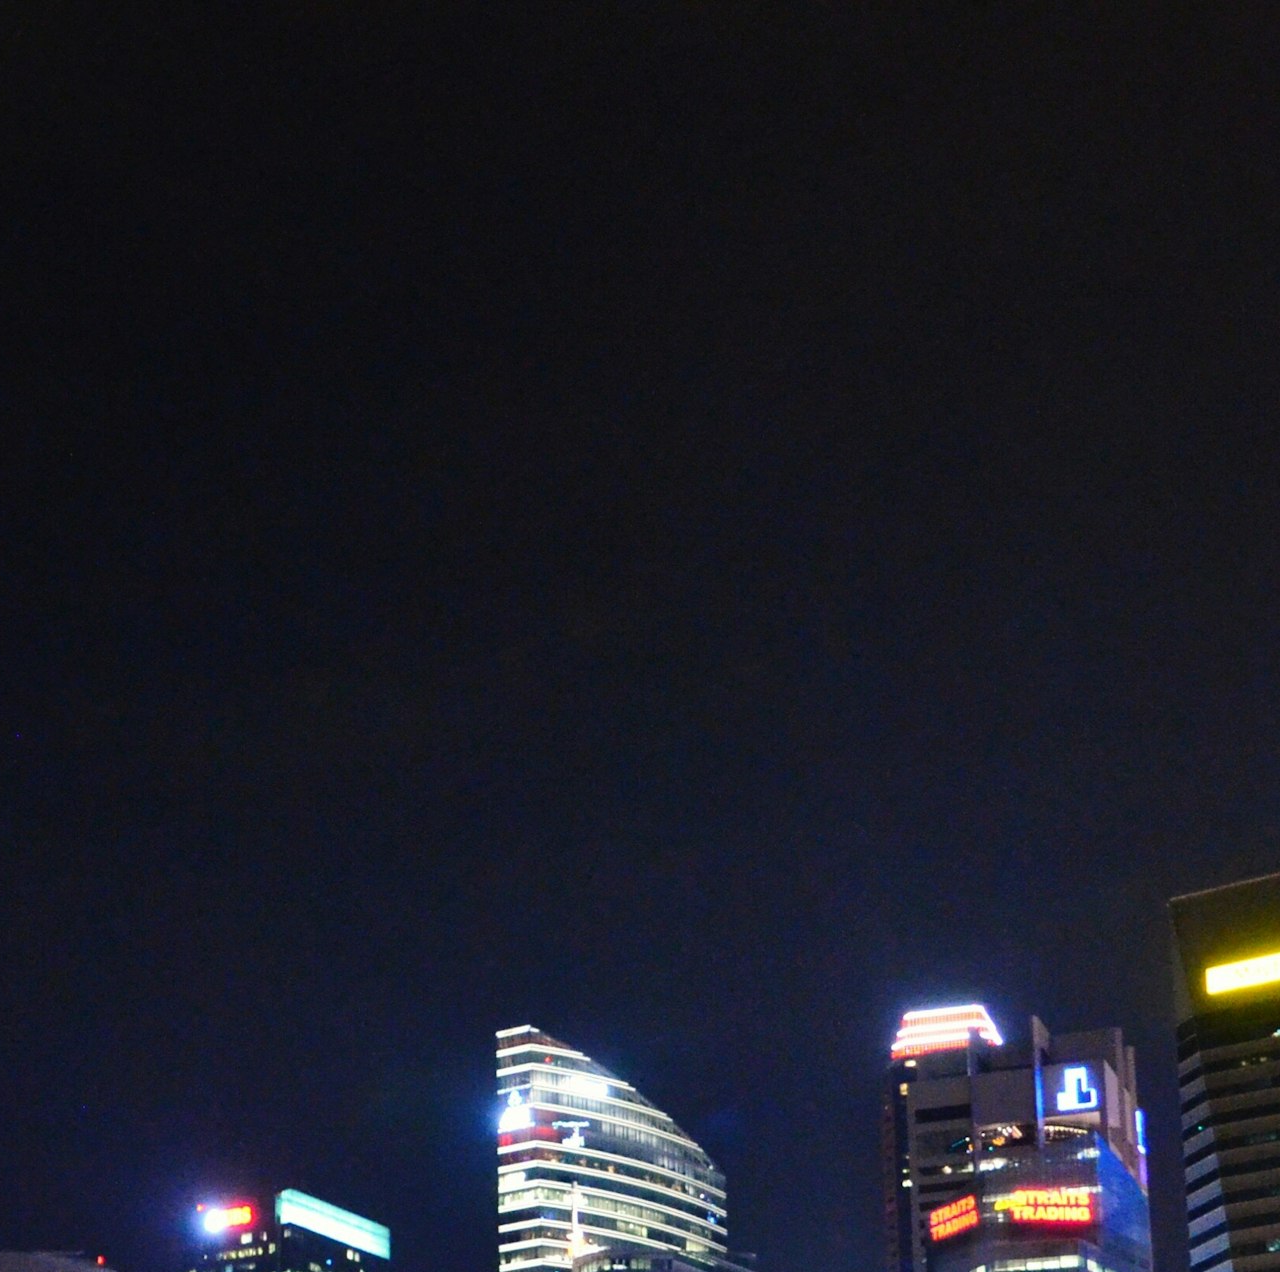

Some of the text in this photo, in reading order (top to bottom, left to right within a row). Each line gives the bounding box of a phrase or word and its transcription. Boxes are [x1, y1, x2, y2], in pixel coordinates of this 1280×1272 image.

[1011, 1189, 1090, 1206] STRAITS
[930, 1195, 975, 1226] STRAITS
[1010, 1206, 1091, 1222] TRADING
[930, 1210, 978, 1241] TRADING
